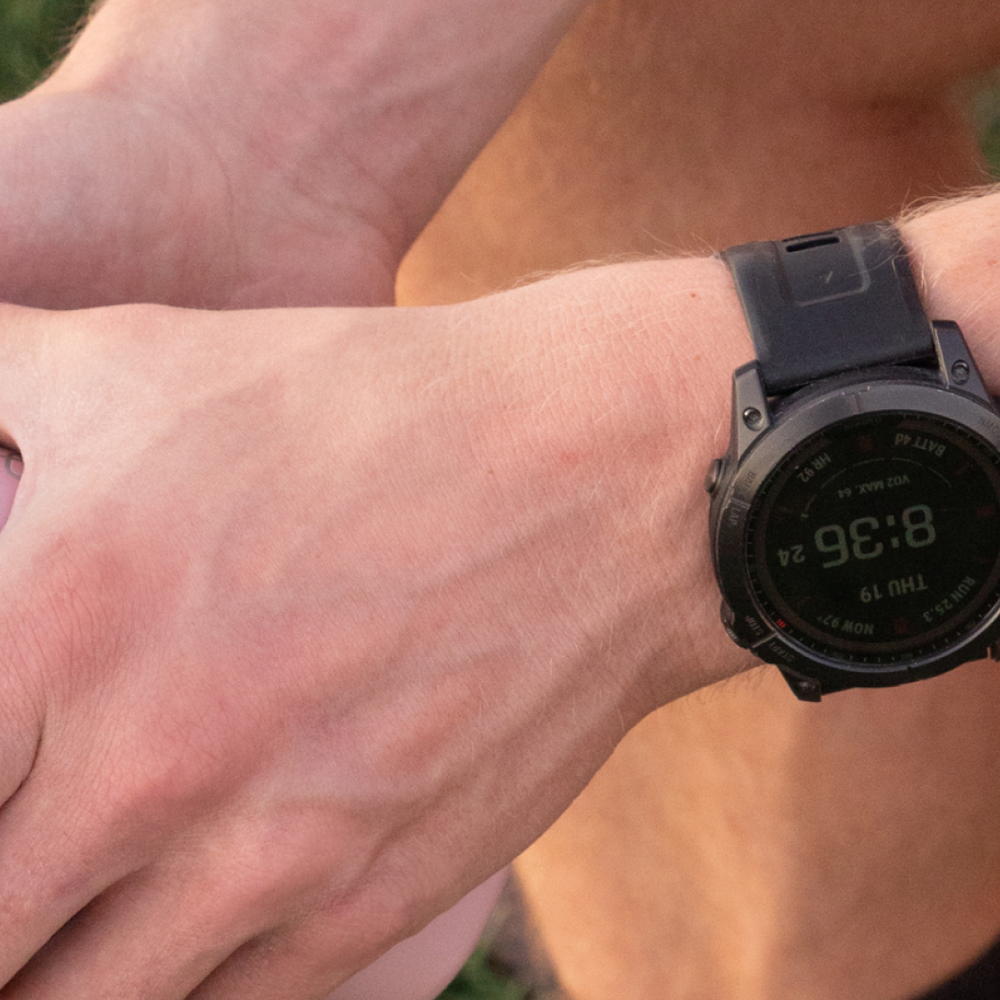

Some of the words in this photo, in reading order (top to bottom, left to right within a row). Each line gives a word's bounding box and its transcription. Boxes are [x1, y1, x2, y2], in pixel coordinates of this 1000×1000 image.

[912, 434, 946, 458] BATT
[811, 452, 831, 472] HR
[797, 465, 815, 483] 92
[814, 503, 937, 569] 8:36
[776, 544, 805, 567] 24
[859, 583, 883, 603] 19
[887, 573, 928, 597] THU
[950, 575, 976, 601] RUN
[922, 597, 953, 623] 25.3
[841, 619, 874, 635] NOW
